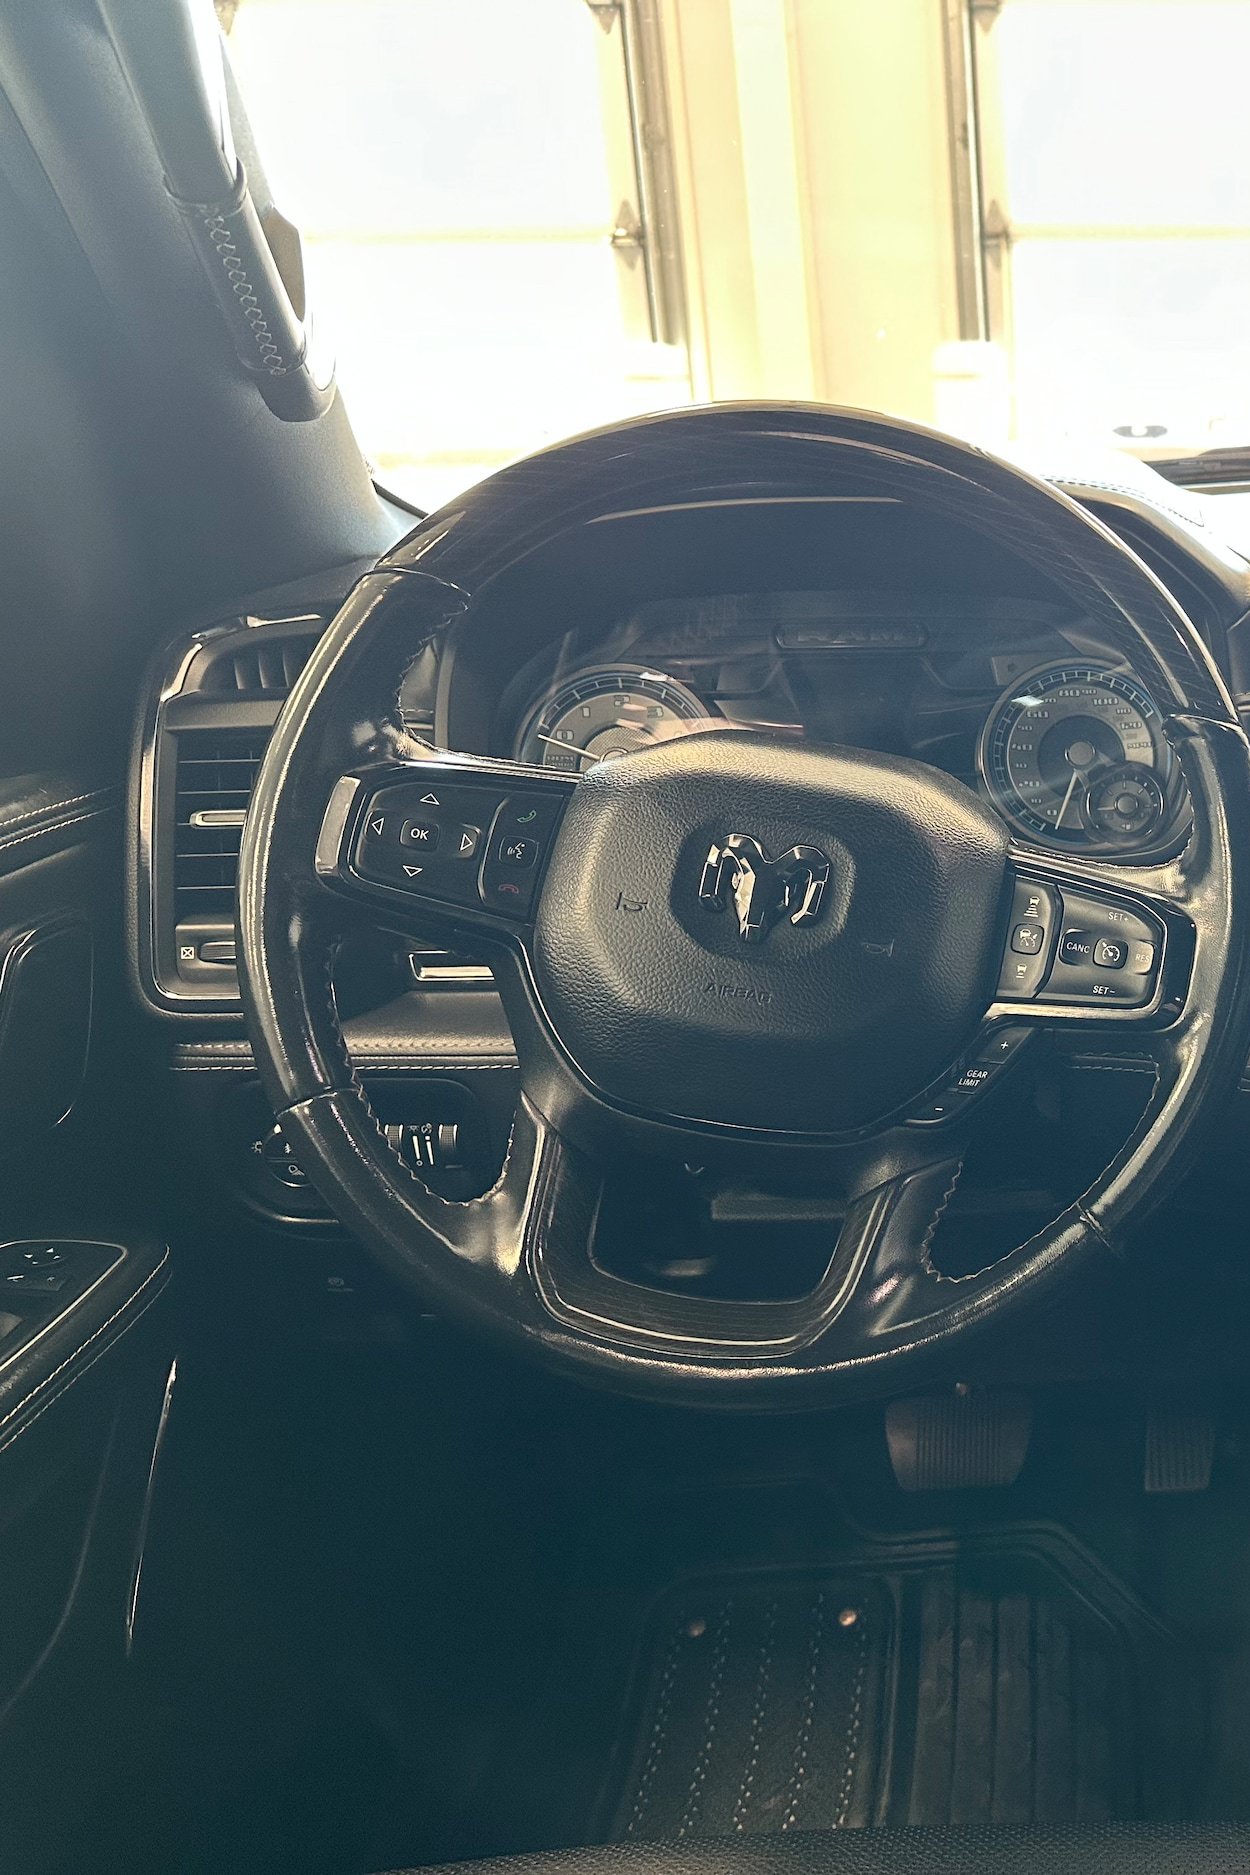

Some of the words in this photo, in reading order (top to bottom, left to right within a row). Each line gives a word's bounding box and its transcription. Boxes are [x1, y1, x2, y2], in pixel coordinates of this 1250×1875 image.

[410, 827, 430, 841] OK
[1066, 941, 1091, 954] CANC
[1135, 953, 1150, 963] RES
[966, 1069, 988, 1079] GEAR
[958, 1078, 980, 1087] LIMIT
